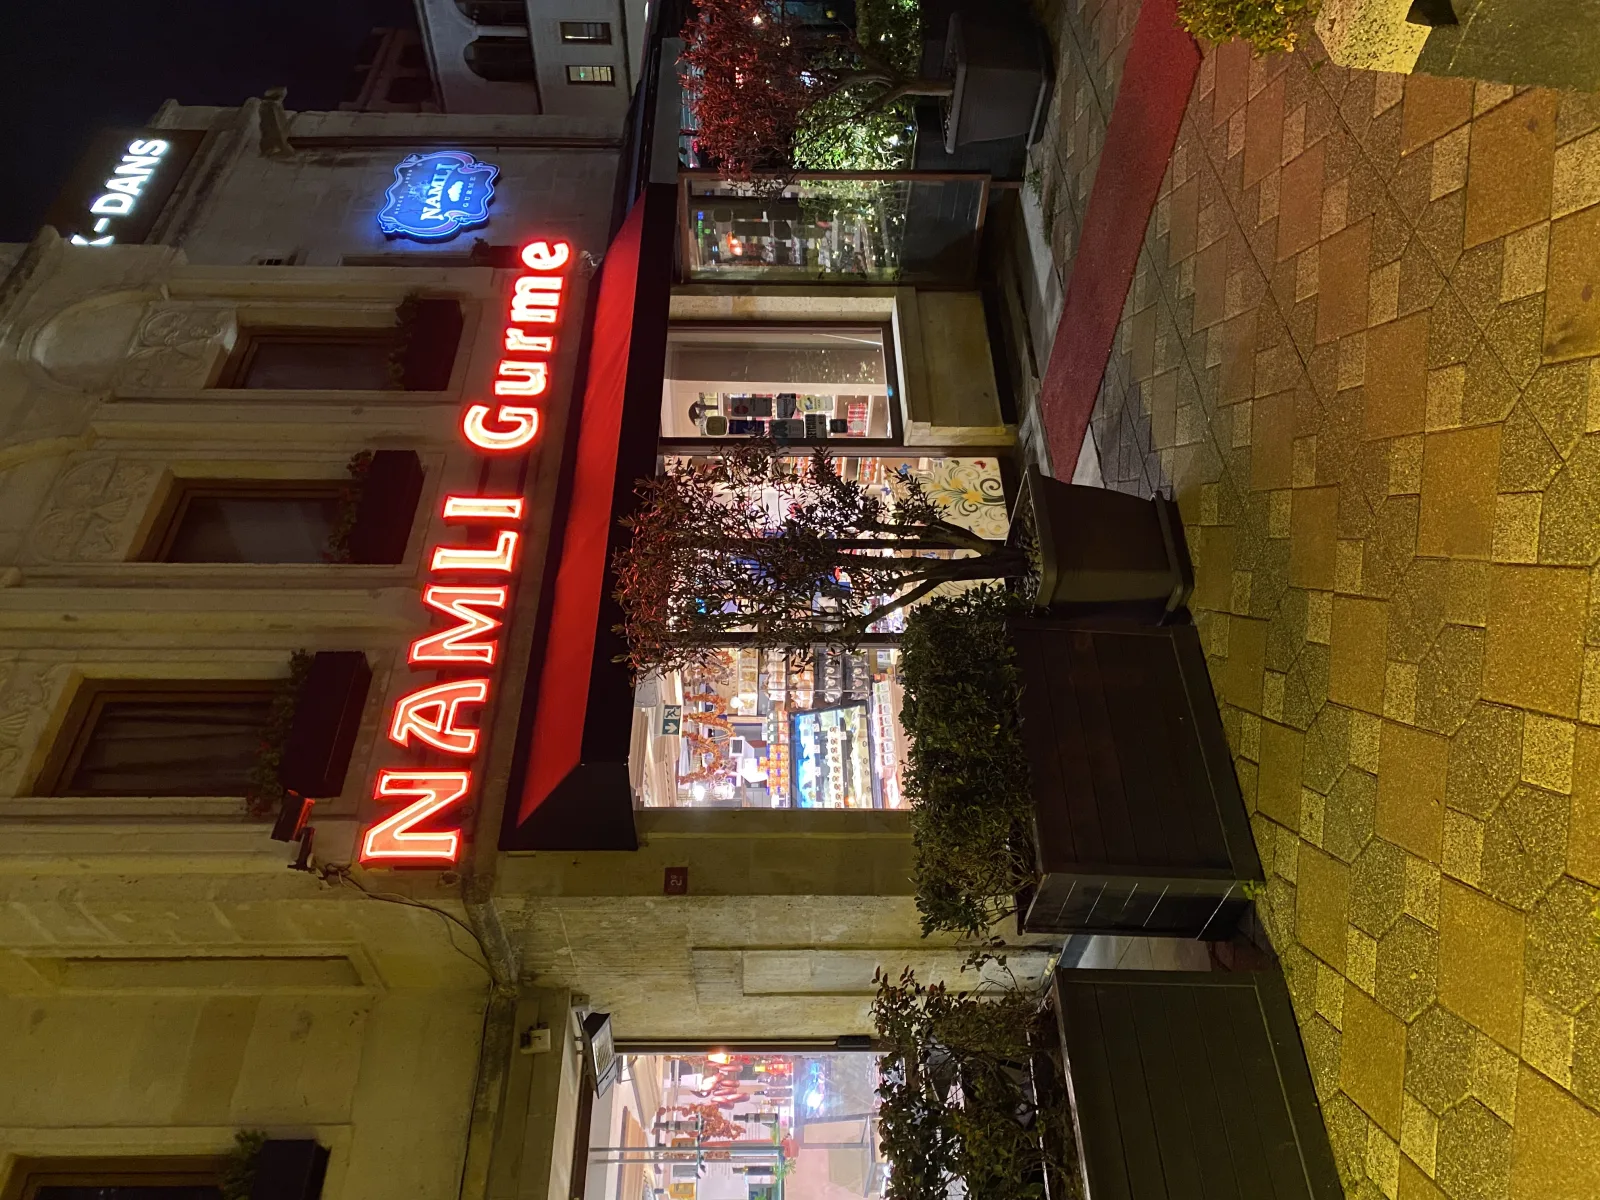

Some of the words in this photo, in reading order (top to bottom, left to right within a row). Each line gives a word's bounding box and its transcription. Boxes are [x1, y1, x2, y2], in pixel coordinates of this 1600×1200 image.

[419, 162, 460, 221] NAMLI
[463, 176, 476, 208] GURME
[358, 494, 524, 863] NAMLI
[461, 239, 572, 452] Gurme
